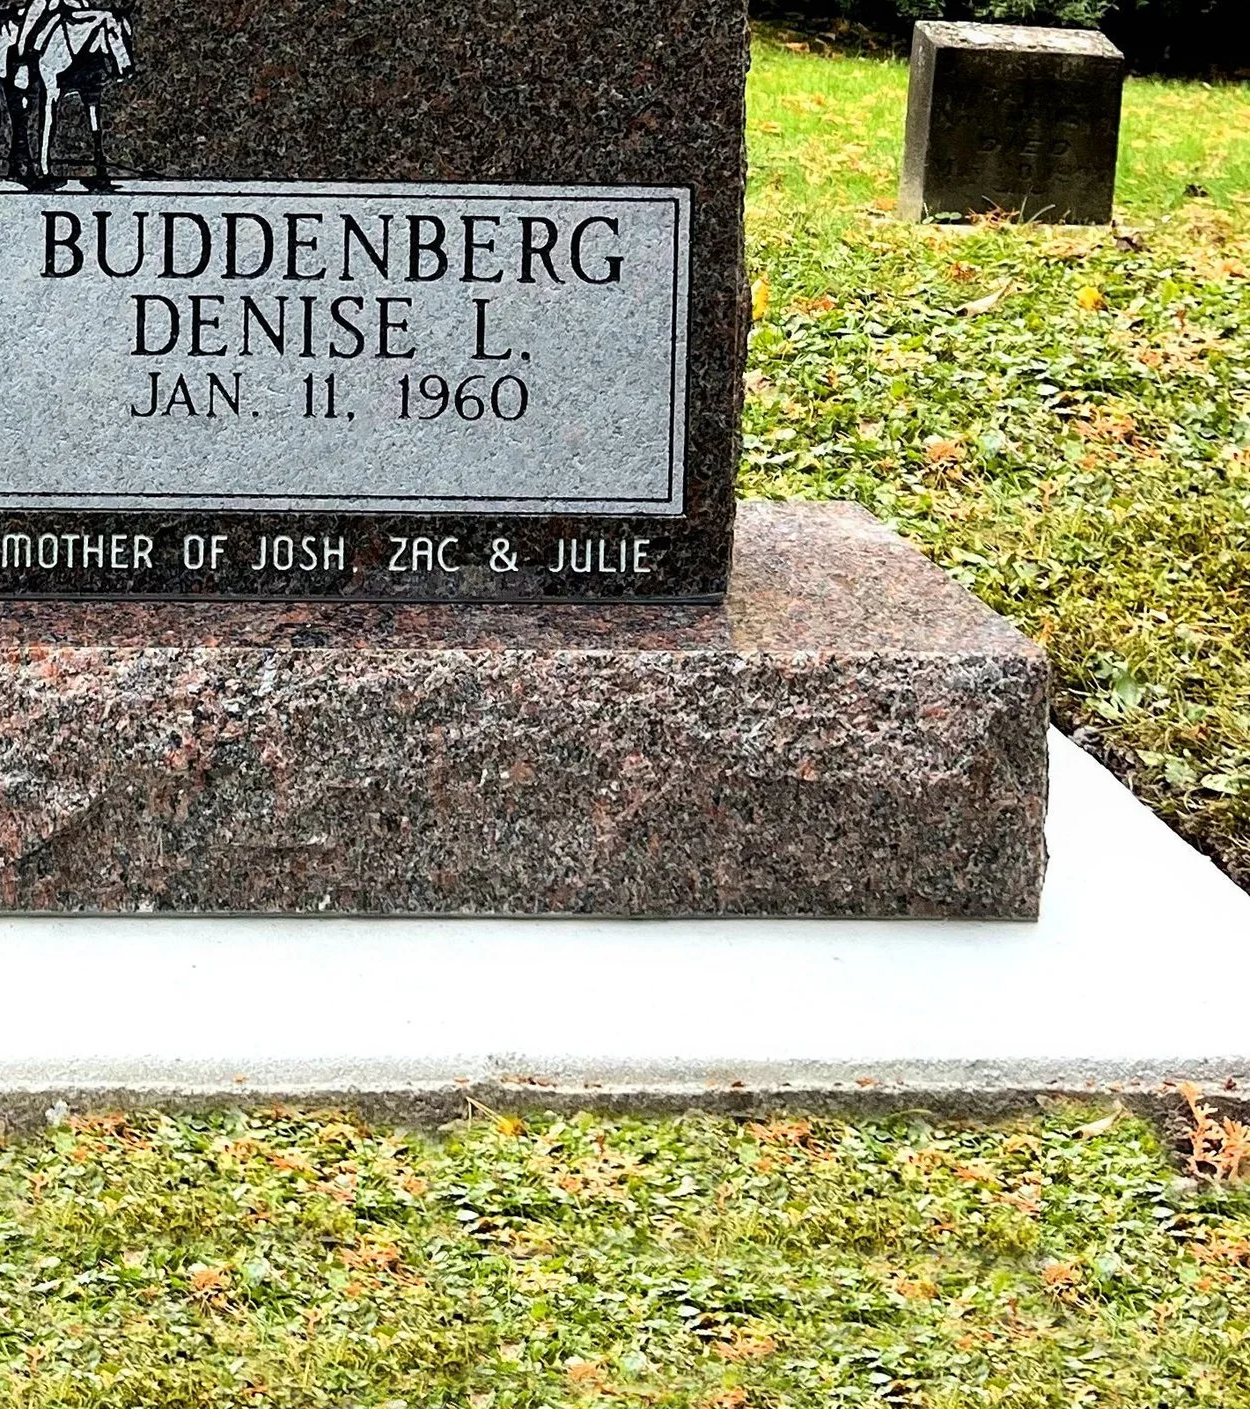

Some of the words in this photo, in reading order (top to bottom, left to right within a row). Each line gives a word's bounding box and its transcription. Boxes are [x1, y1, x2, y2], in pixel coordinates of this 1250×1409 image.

[41, 210, 624, 284] BUDDENBERG
[130, 294, 418, 360] DENISE
[471, 297, 532, 361] L.
[130, 372, 261, 418] JAN.
[303, 374, 356, 421] 11,
[398, 374, 529, 421] 1960
[1, 534, 153, 570] MOTHER
[184, 534, 228, 570] OF
[389, 536, 458, 573] ZAC
[490, 538, 519, 572] &
[549, 538, 651, 573] JULIE
